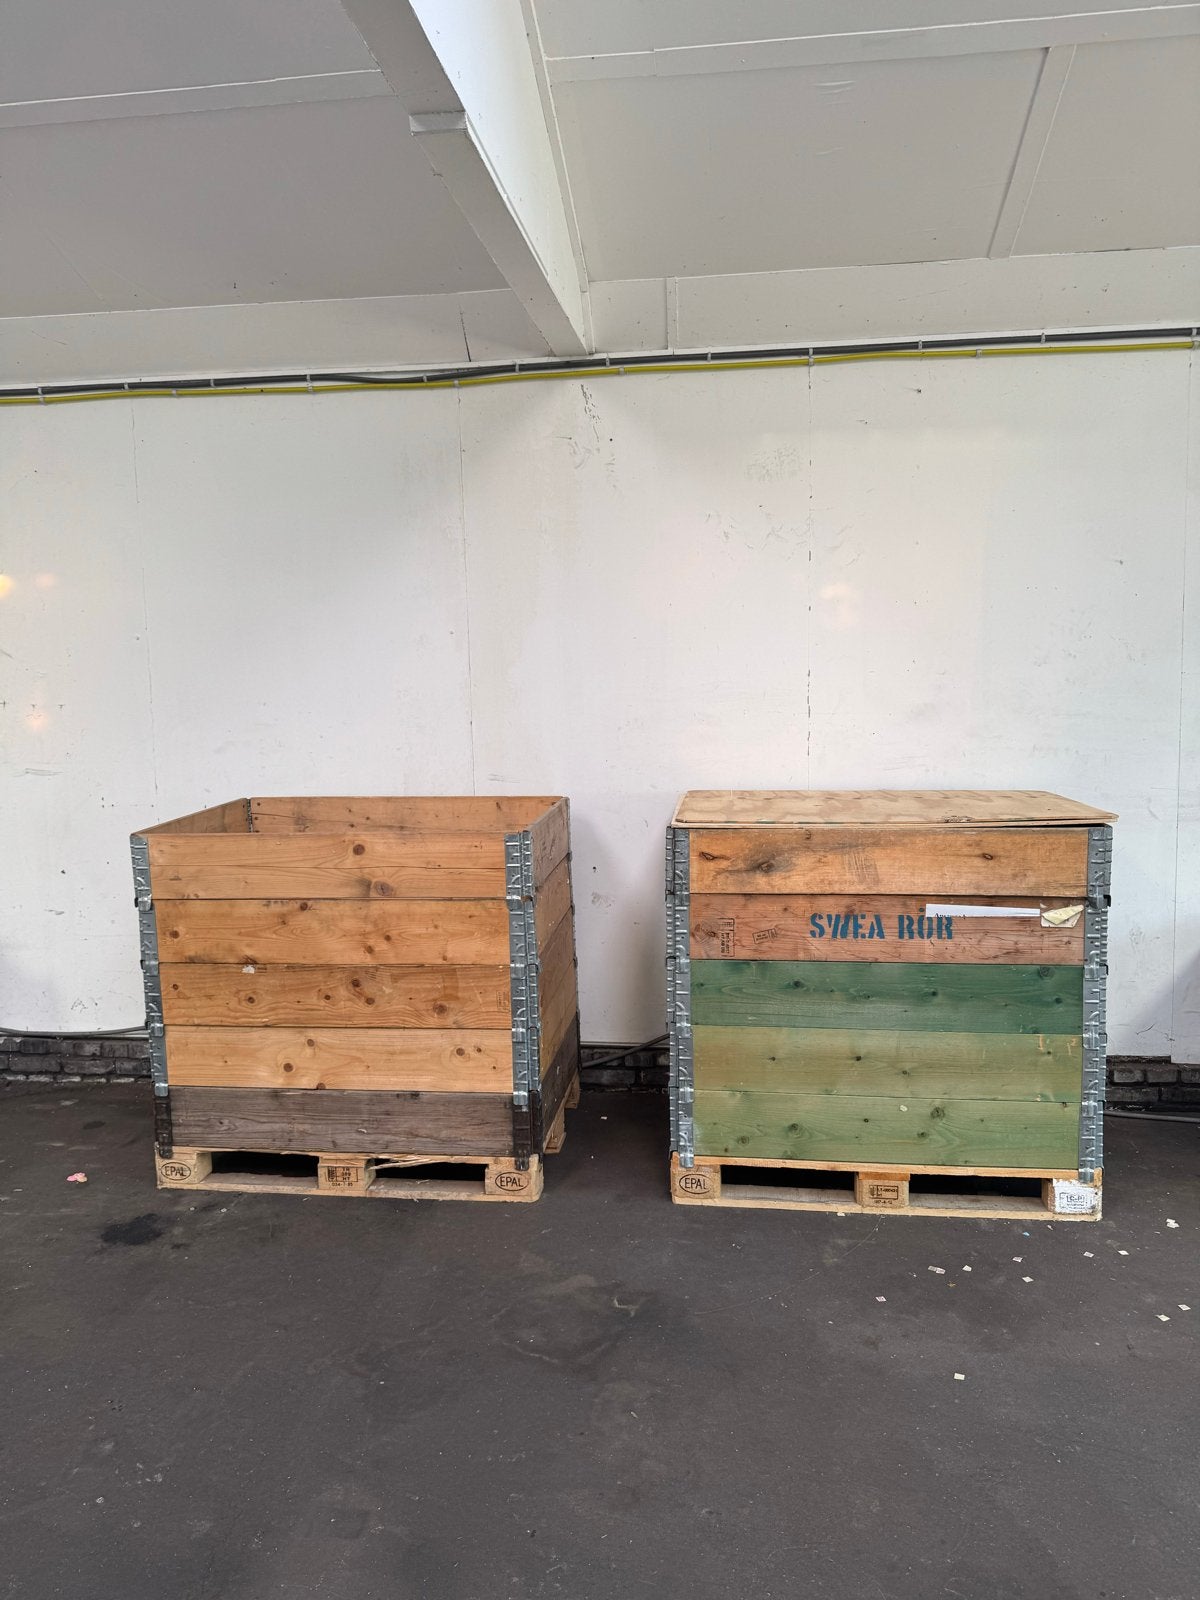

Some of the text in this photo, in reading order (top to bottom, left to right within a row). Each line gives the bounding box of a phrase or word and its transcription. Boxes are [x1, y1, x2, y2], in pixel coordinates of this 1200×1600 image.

[810, 912, 885, 939] SWEA
[164, 1165, 187, 1177] EPAL
[500, 1176, 524, 1188] EPAL
[684, 1177, 707, 1190] EPAL
